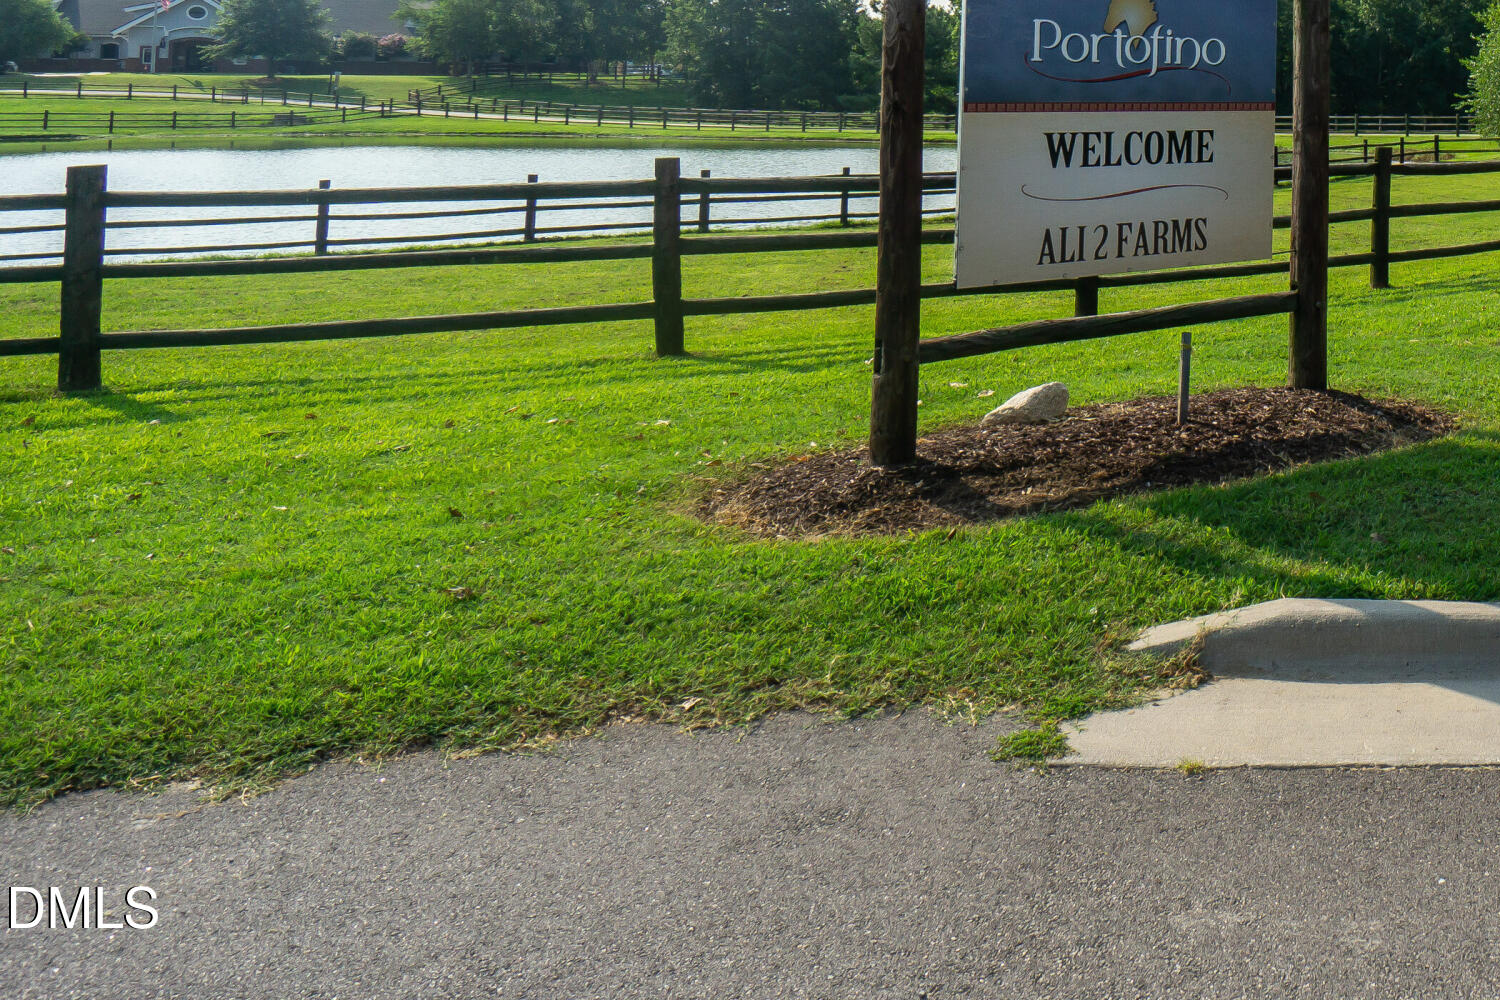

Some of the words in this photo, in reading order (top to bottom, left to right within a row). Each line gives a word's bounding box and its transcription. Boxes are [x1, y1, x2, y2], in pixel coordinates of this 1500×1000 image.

[1030, 19, 1227, 77] Portofino
[1043, 129, 1215, 168] WELCOME
[1036, 224, 1087, 265] ALI
[1093, 224, 1109, 260] 2
[1116, 217, 1208, 258] FARMS
